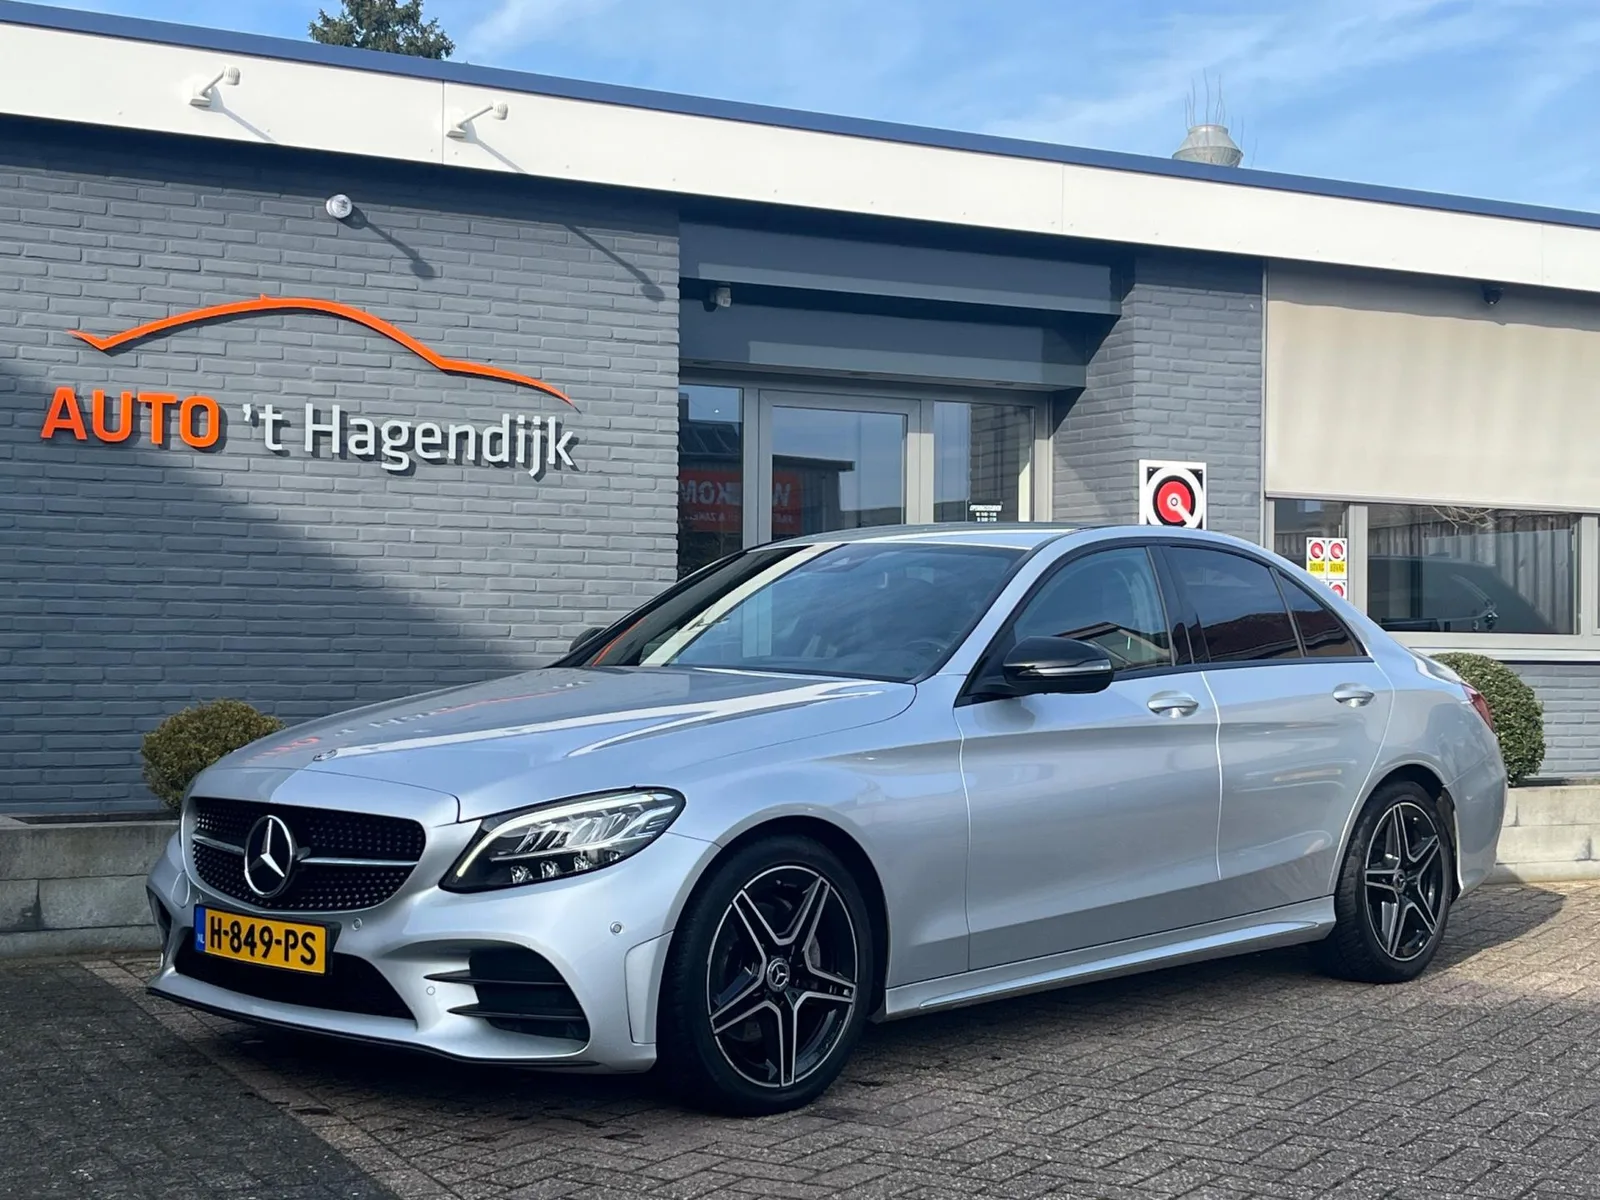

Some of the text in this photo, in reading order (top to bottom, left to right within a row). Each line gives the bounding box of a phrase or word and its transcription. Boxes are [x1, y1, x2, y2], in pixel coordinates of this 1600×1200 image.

[40, 386, 220, 448] AUTO
[304, 402, 574, 478] Hagendijk
[210, 916, 317, 966] H-849-PS
